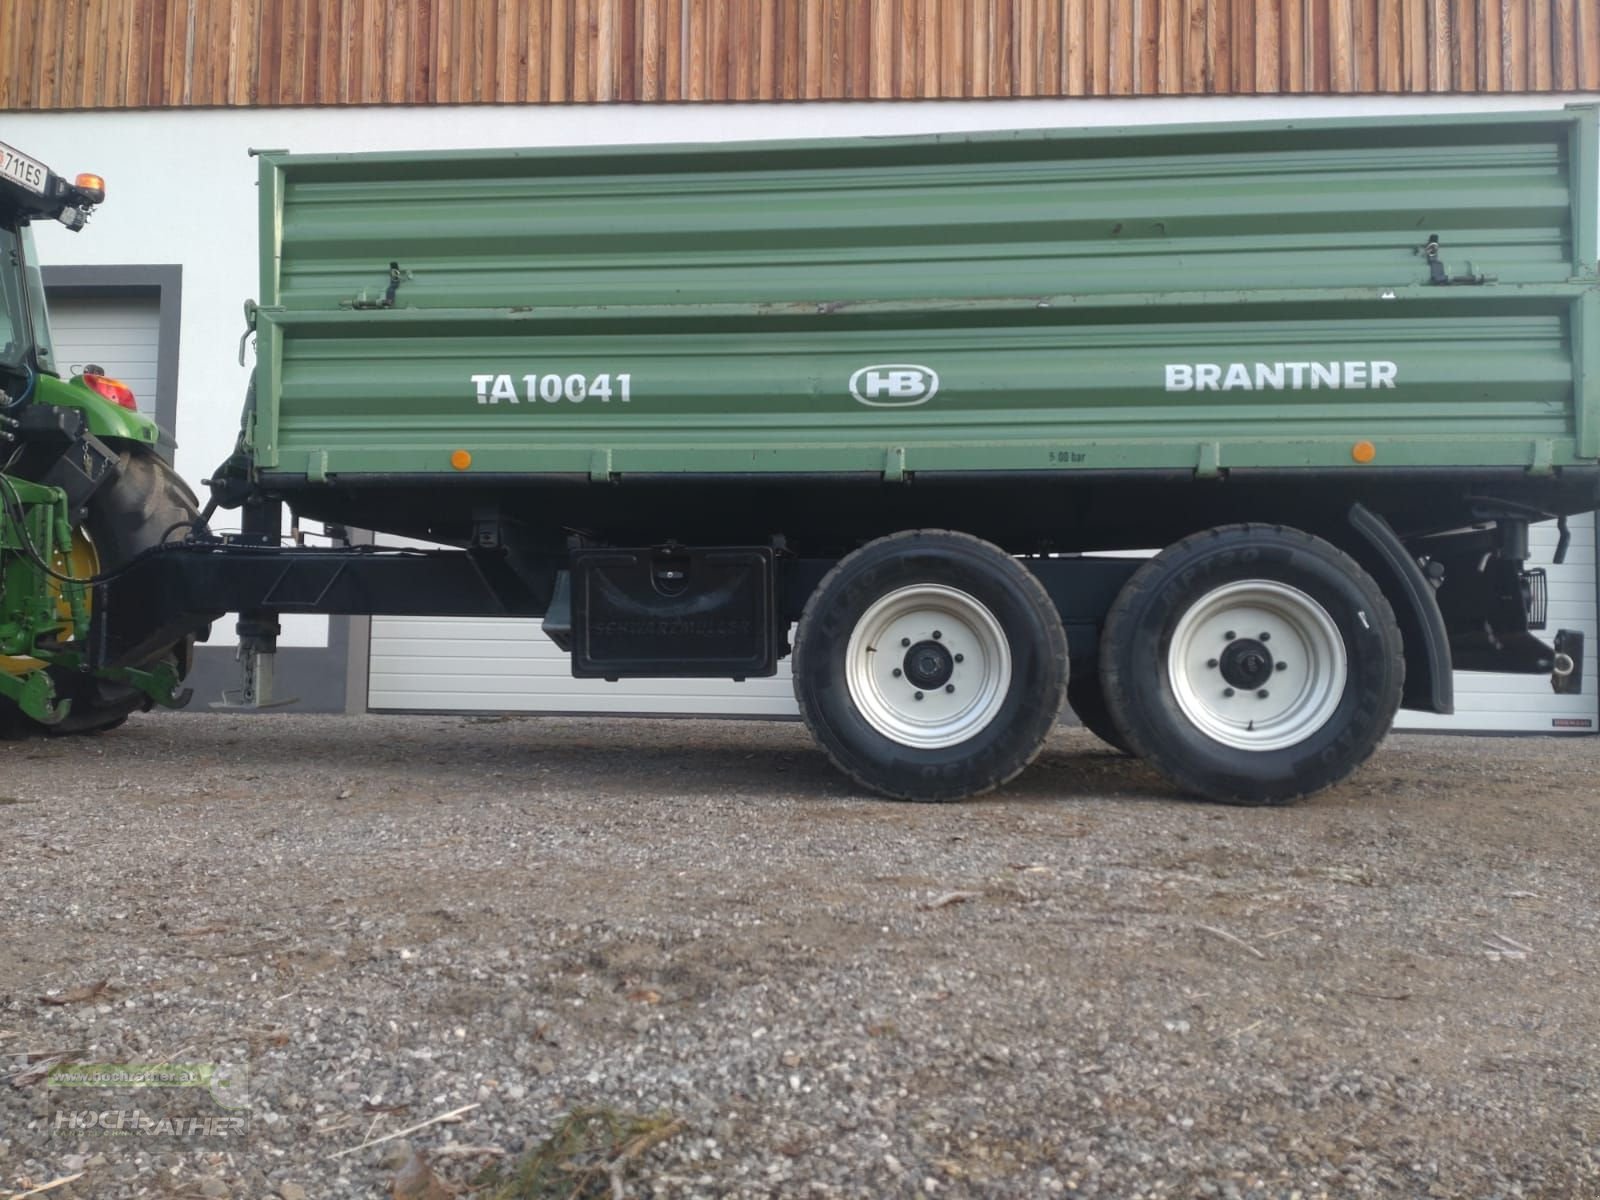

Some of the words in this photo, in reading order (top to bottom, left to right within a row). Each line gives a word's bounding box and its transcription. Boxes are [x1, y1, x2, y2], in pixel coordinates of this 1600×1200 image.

[470, 373, 520, 405] TA
[522, 373, 632, 404] 10041
[866, 371, 926, 398] HB
[1164, 360, 1398, 392] BRANTNER
